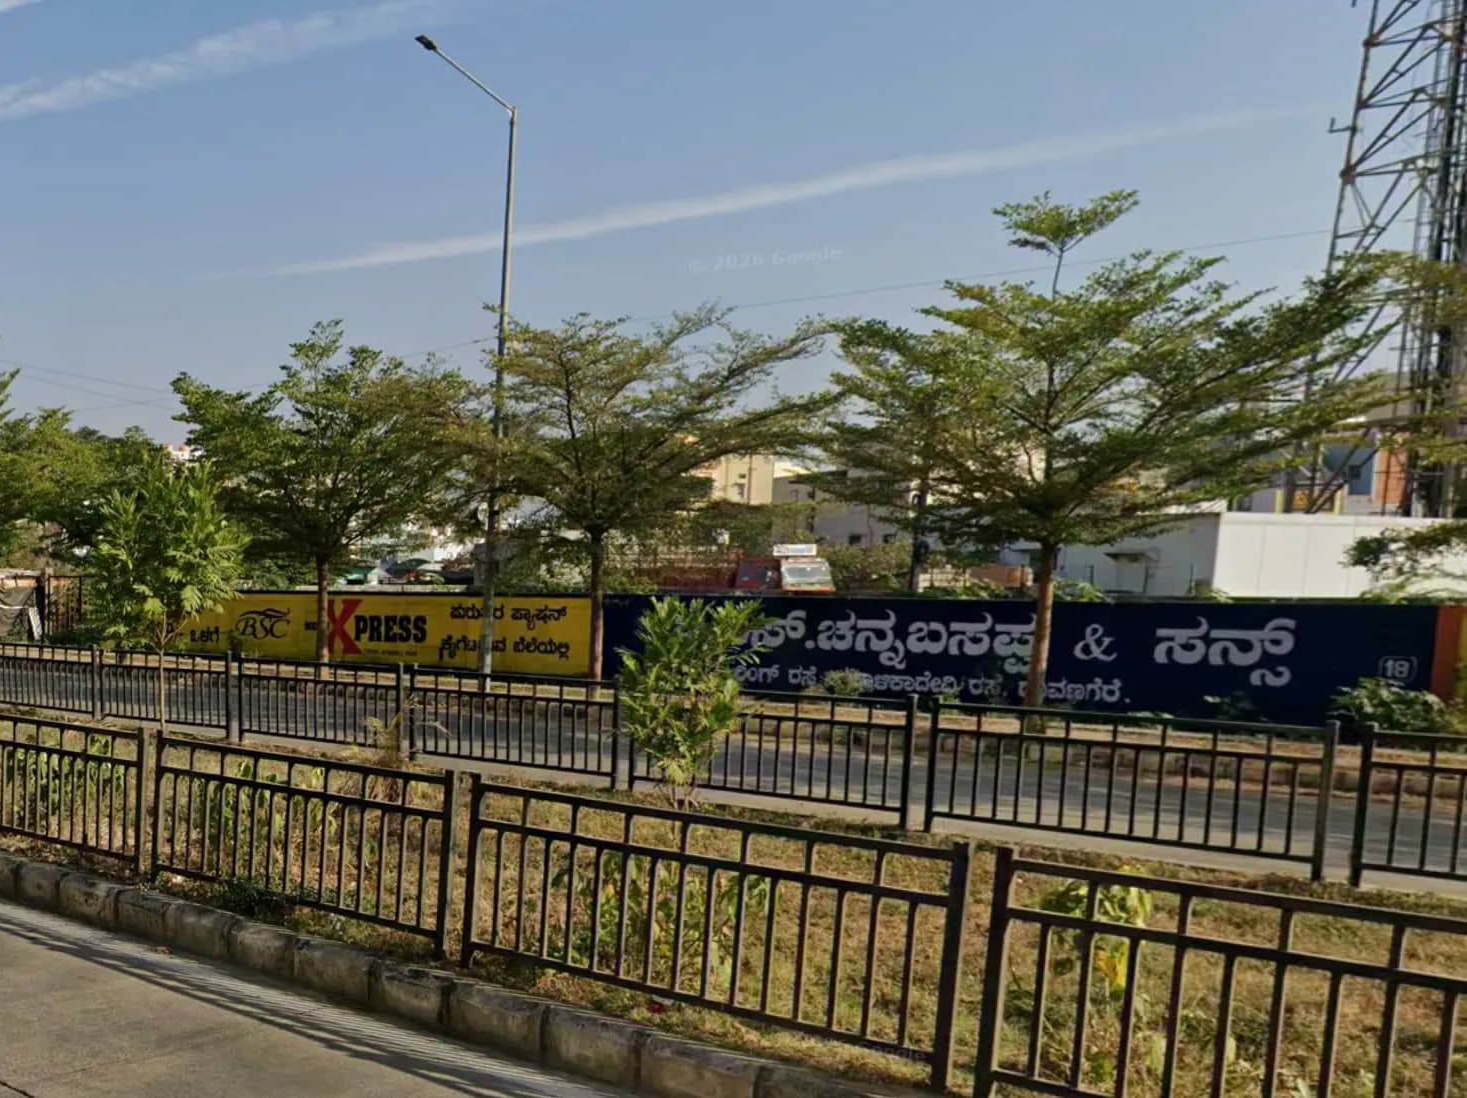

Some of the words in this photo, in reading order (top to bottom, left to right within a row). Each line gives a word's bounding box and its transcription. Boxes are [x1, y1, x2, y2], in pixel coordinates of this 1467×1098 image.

[235, 612, 290, 640] BSC
[738, 609, 1037, 674] ಸ್.ಚನ್ನಬಸಪ್ಪ
[1073, 623, 1118, 662] &
[1154, 616, 1297, 686] ಸನ್ಸ್
[1384, 659, 1411, 678] 18
